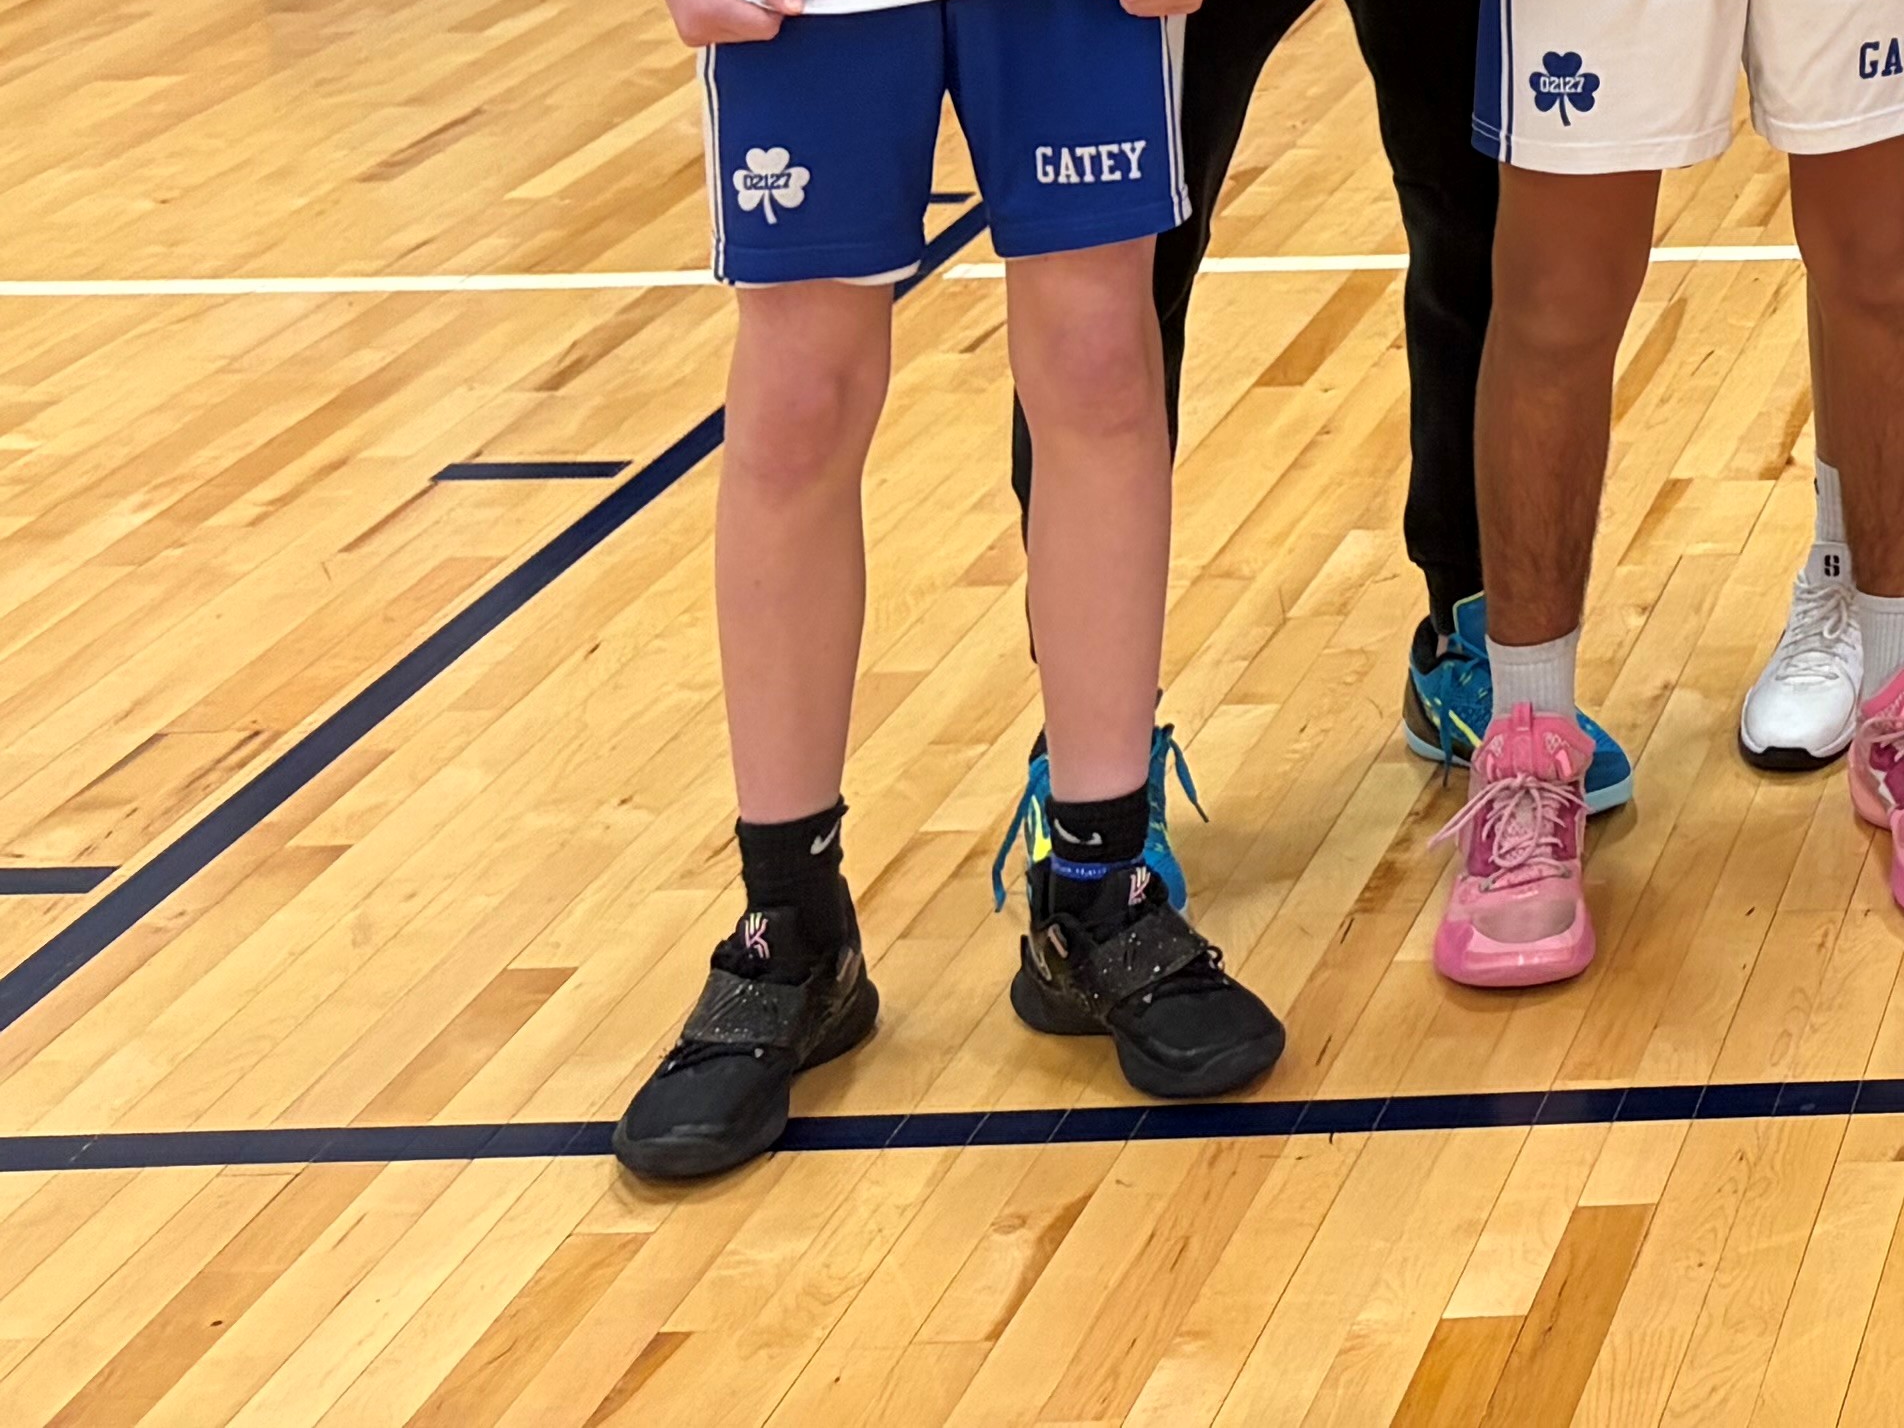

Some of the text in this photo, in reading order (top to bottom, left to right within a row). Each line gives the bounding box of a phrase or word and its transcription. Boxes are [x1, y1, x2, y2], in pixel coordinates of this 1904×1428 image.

[1539, 74, 1585, 95] 02127
[1035, 140, 1146, 184] GATEY
[743, 172, 792, 190] 02127
